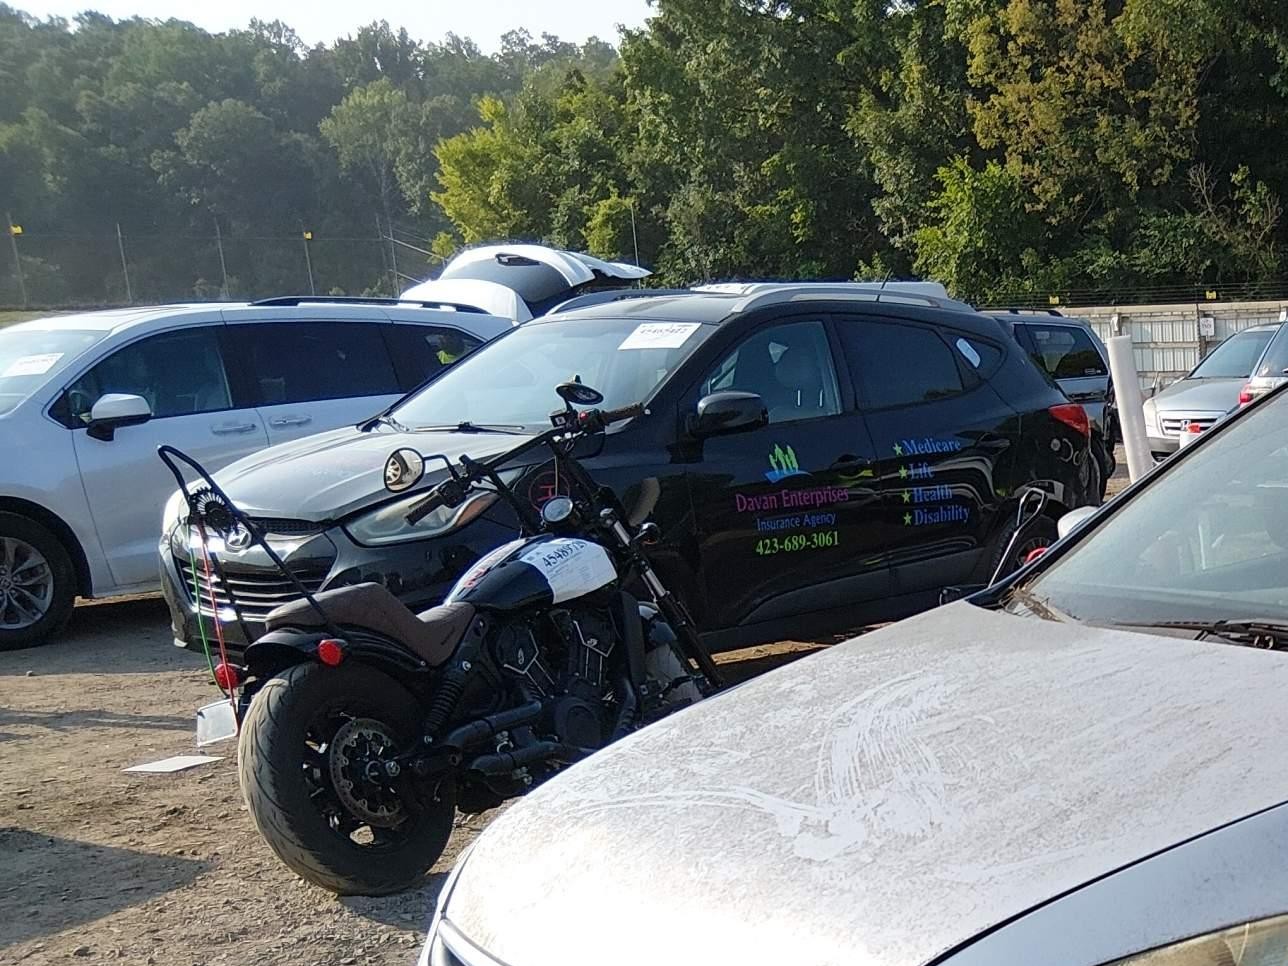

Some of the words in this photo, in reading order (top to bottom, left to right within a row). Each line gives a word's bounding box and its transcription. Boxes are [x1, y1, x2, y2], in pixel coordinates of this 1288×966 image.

[902, 438, 961, 456] Medicare
[909, 462, 935, 480] Life
[736, 492, 777, 513] Davan
[781, 486, 849, 508] Enterprises
[913, 484, 953, 503] Health
[757, 516, 801, 531] Insurance
[803, 512, 837, 528] Agency
[914, 504, 970, 525] Disability
[755, 530, 840, 555] 423-689-3061
